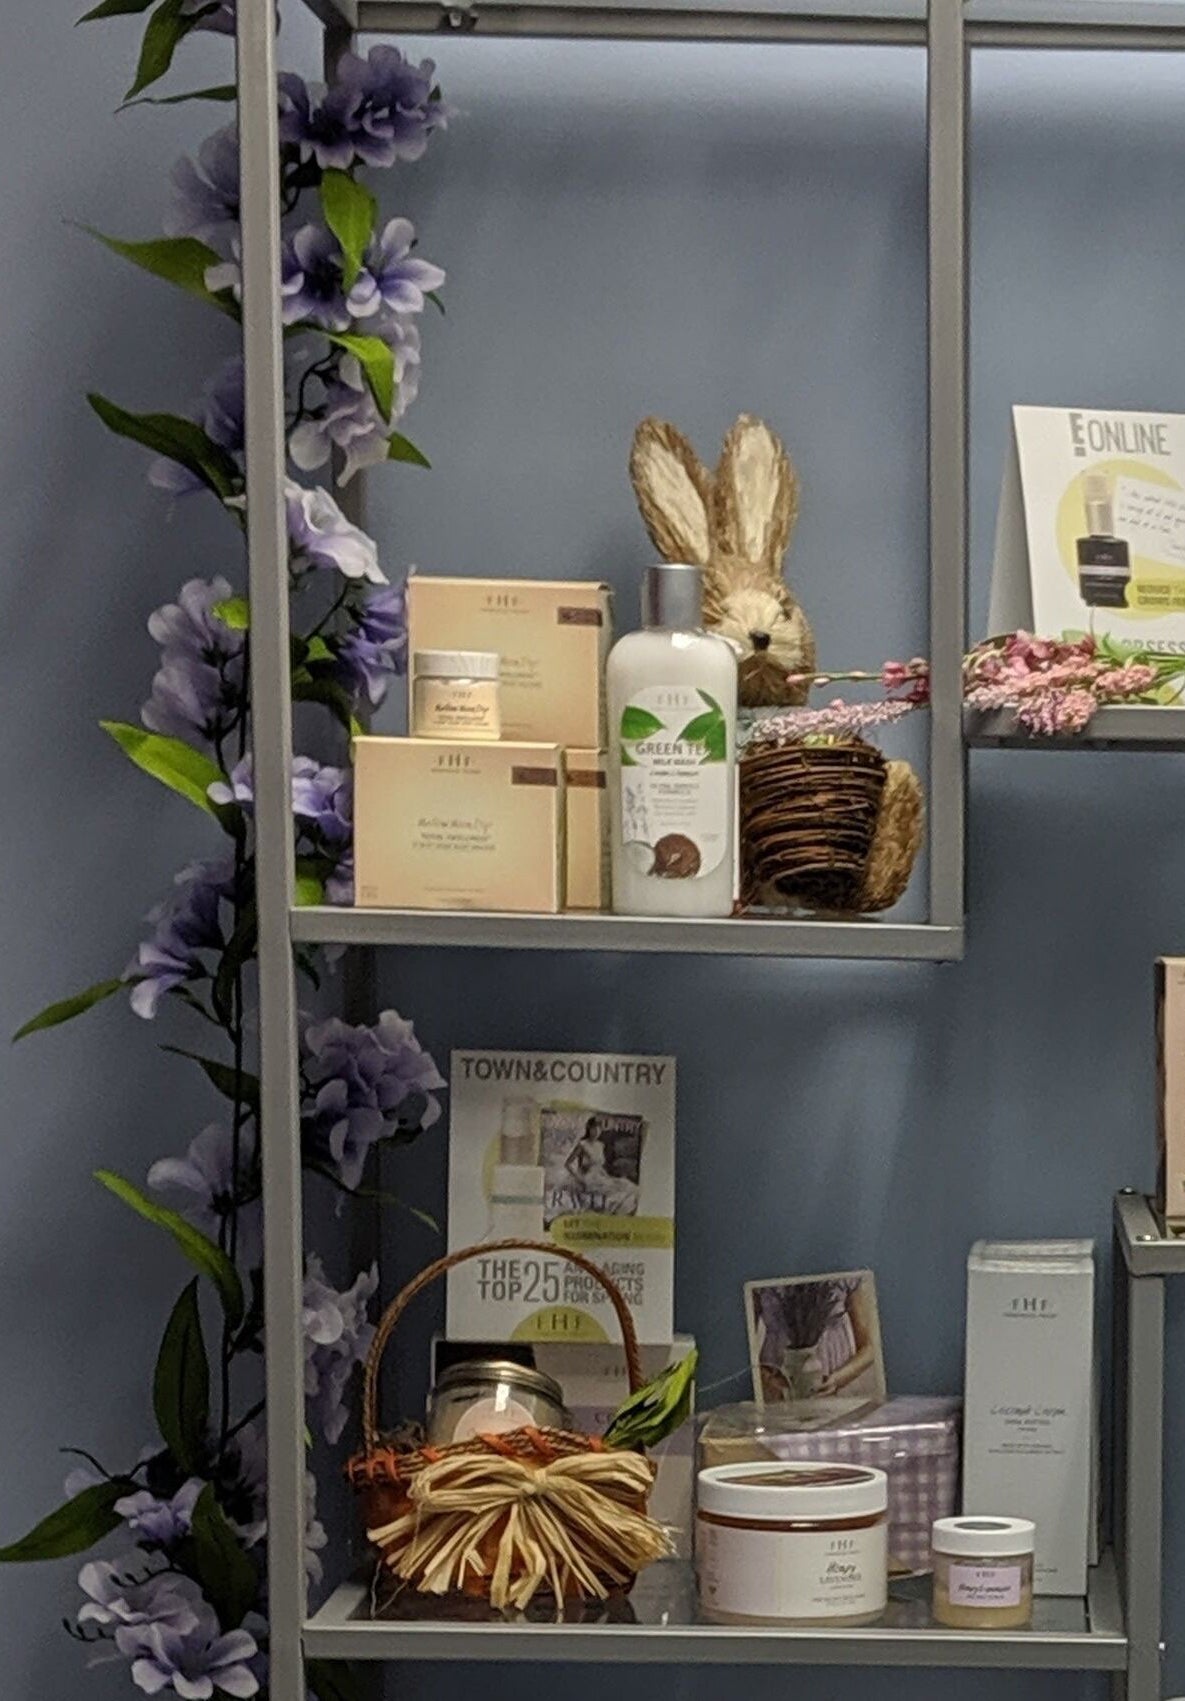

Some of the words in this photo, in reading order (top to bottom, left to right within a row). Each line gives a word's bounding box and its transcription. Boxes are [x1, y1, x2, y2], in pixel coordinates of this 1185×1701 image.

[635, 741, 683, 755] GREEN
[460, 1057, 667, 1086] TOWN&COUNTRY
[477, 1258, 521, 1280] THE
[523, 1260, 560, 1303] 25
[477, 1280, 523, 1302] TOP
